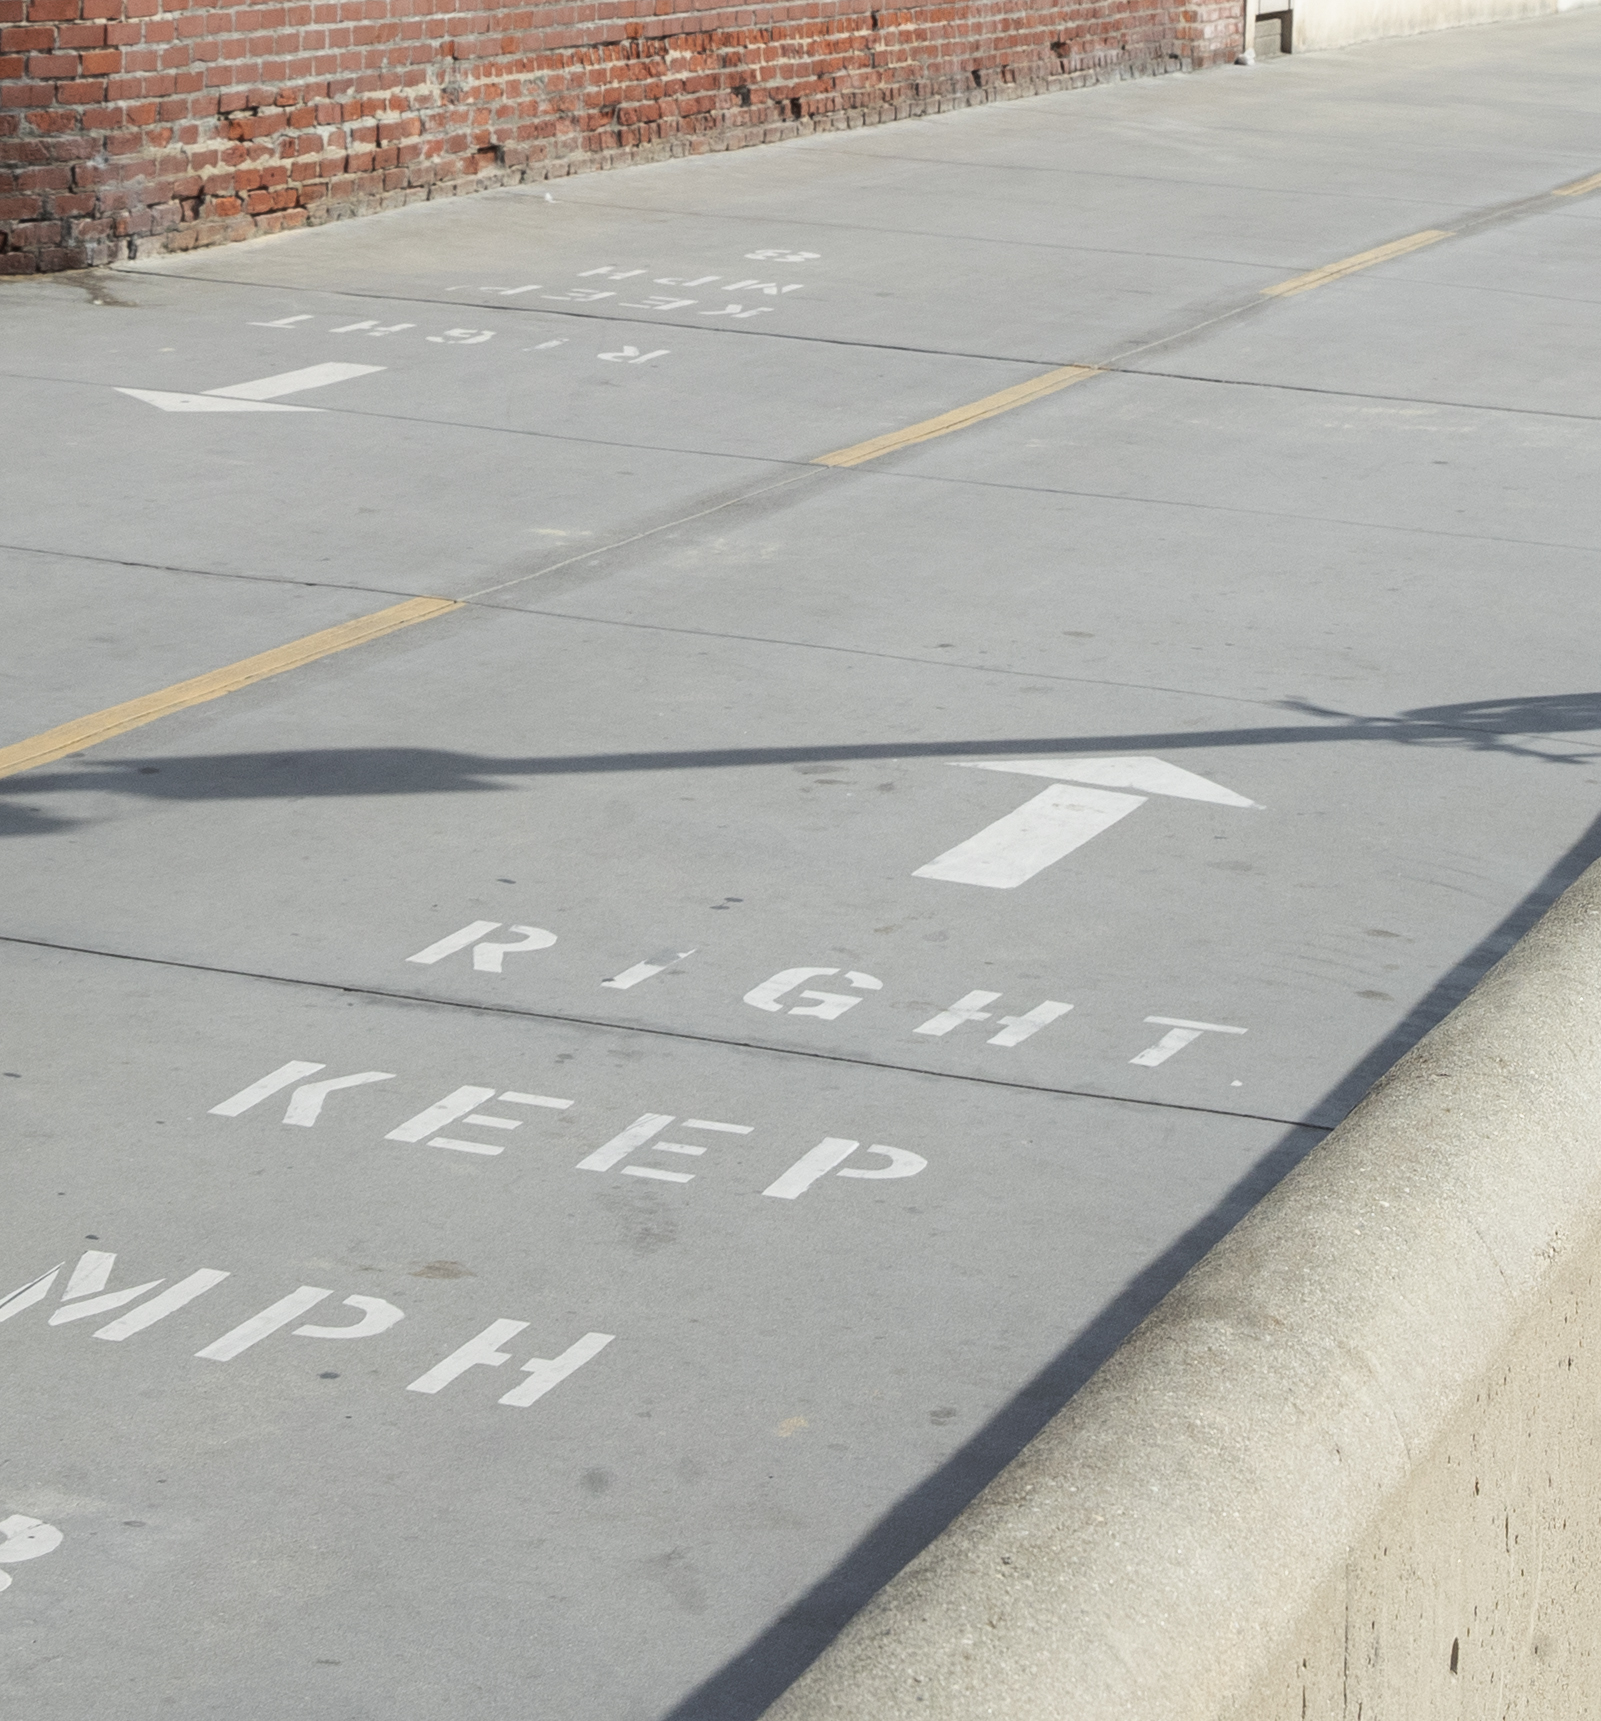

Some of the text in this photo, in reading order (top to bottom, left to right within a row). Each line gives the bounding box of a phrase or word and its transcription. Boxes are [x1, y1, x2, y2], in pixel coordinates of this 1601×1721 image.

[477, 284, 775, 318] KEEP
[577, 266, 804, 295] MPH
[247, 314, 671, 364] RIGHT
[405, 920, 1249, 1068] RIGHT
[207, 1060, 929, 1200] KEEP
